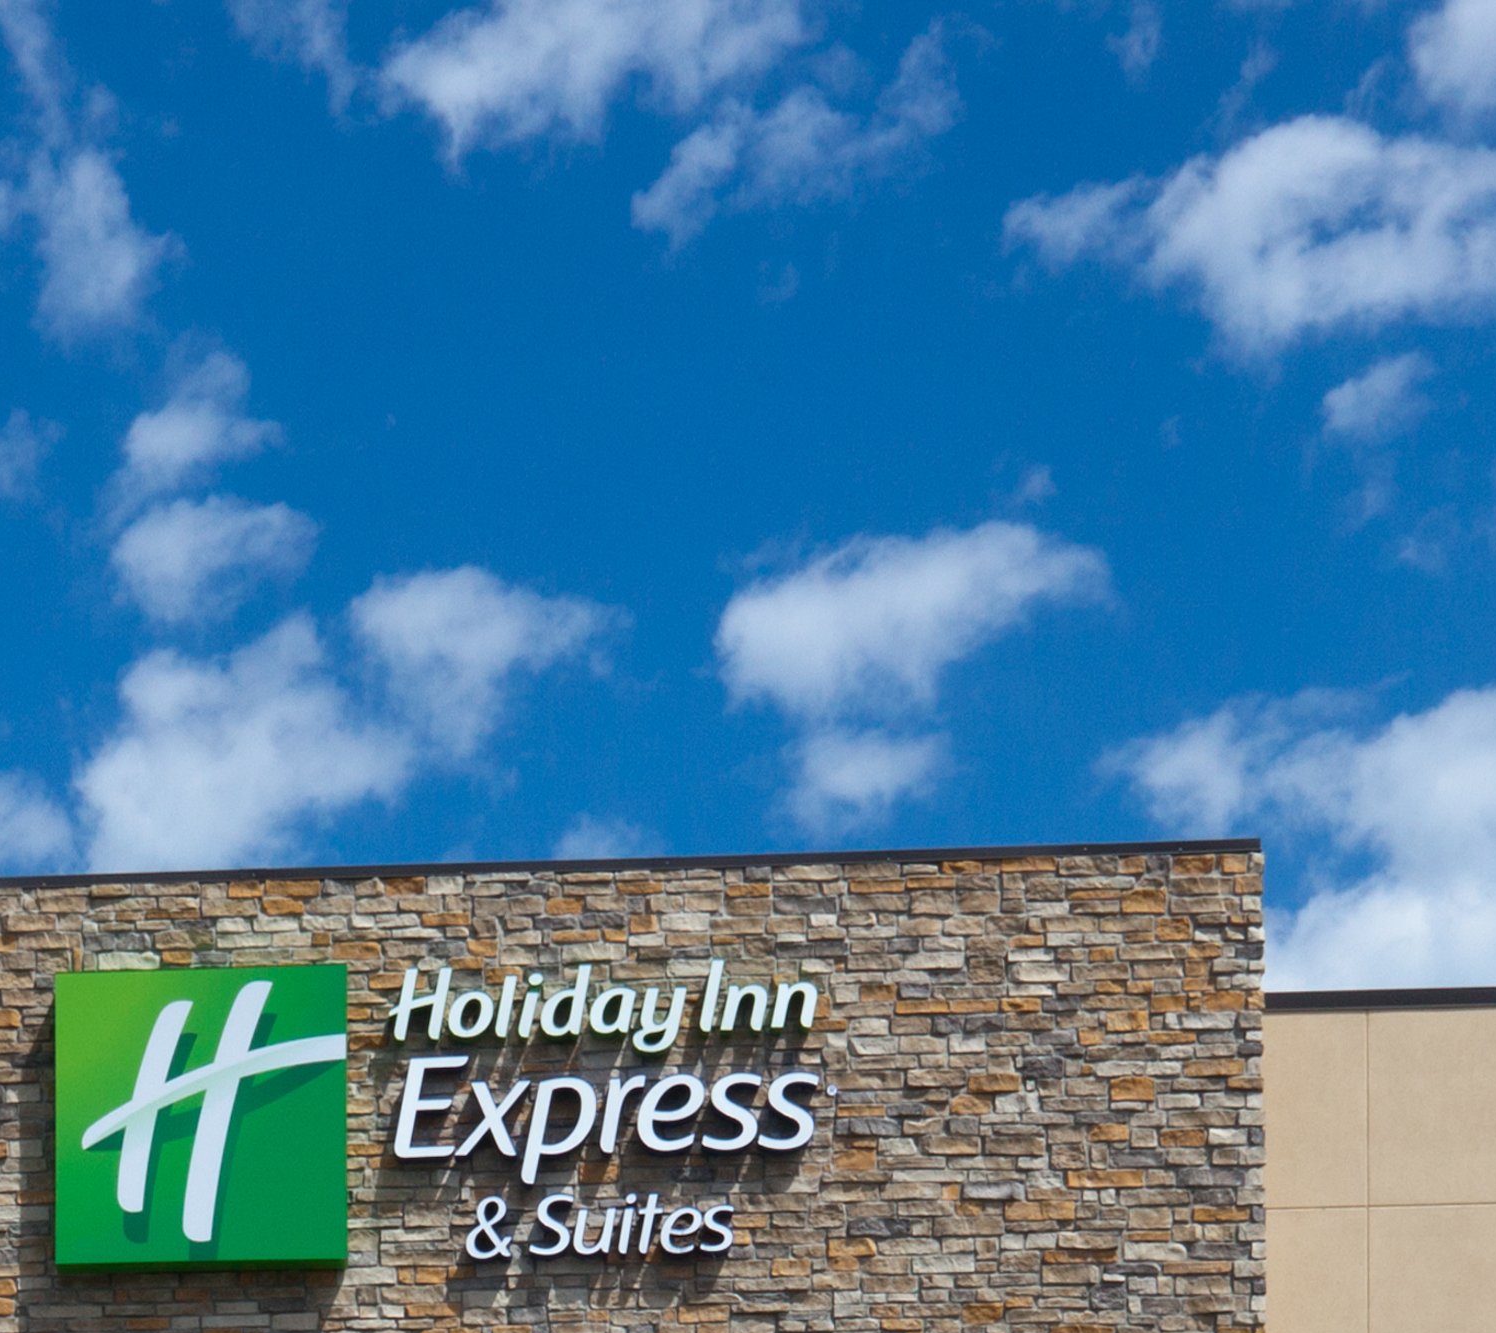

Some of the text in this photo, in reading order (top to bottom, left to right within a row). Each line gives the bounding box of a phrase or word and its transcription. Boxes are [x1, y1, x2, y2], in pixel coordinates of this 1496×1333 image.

[388, 959, 819, 1053] Holiday Inn
[392, 1055, 821, 1185] Express
[465, 1193, 735, 1260] & Suites
